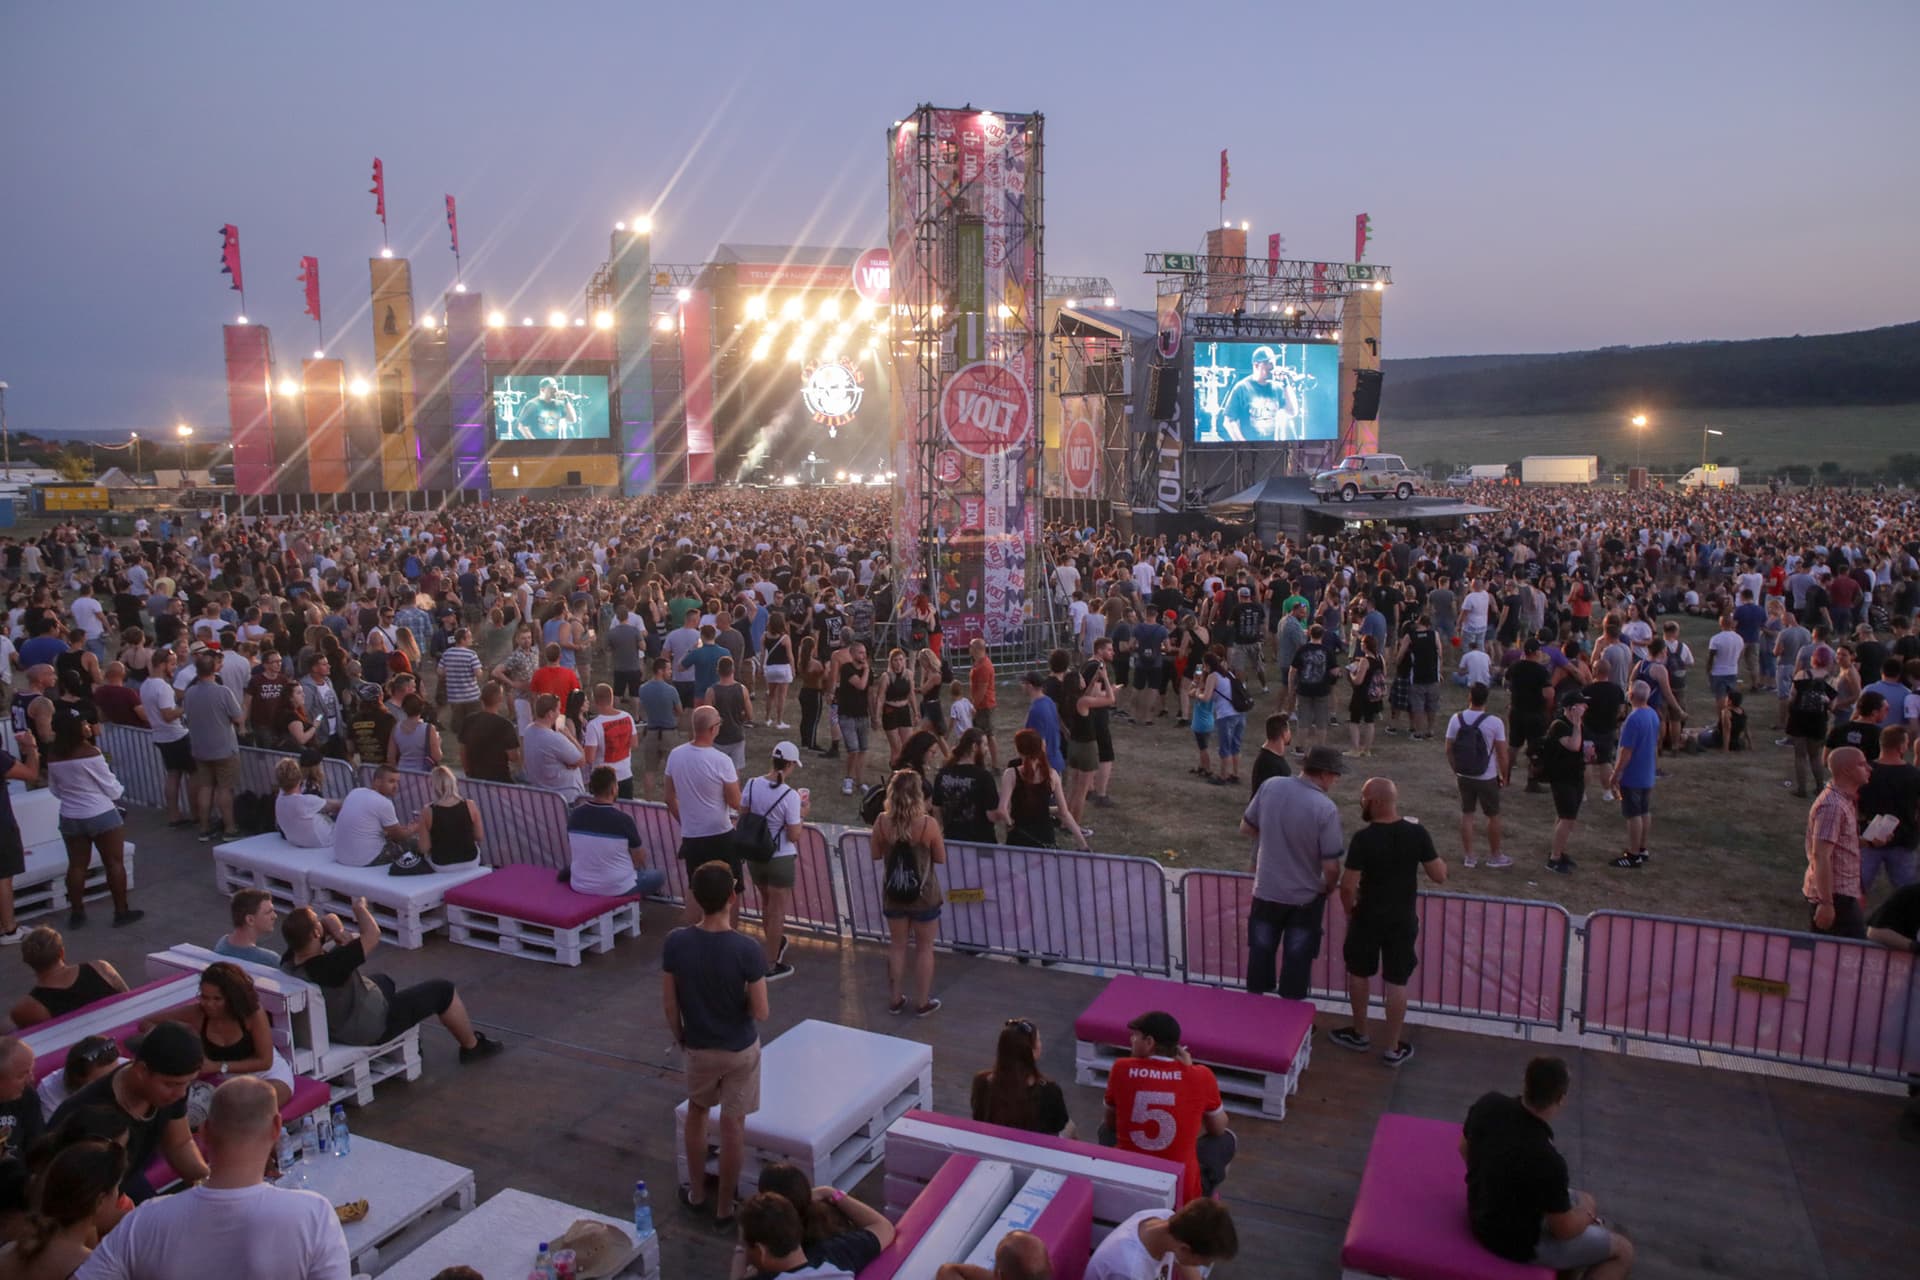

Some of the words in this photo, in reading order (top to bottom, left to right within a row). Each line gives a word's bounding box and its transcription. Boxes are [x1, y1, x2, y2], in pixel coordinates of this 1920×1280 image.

[965, 153, 978, 179] VOLT
[959, 390, 1019, 434] VOLT
[1070, 446, 1092, 471] VOLT
[966, 502, 978, 526] VOLT
[988, 506, 997, 527] 2012
[1128, 1067, 1182, 1081] HOMME
[1129, 1091, 1177, 1151] 5
